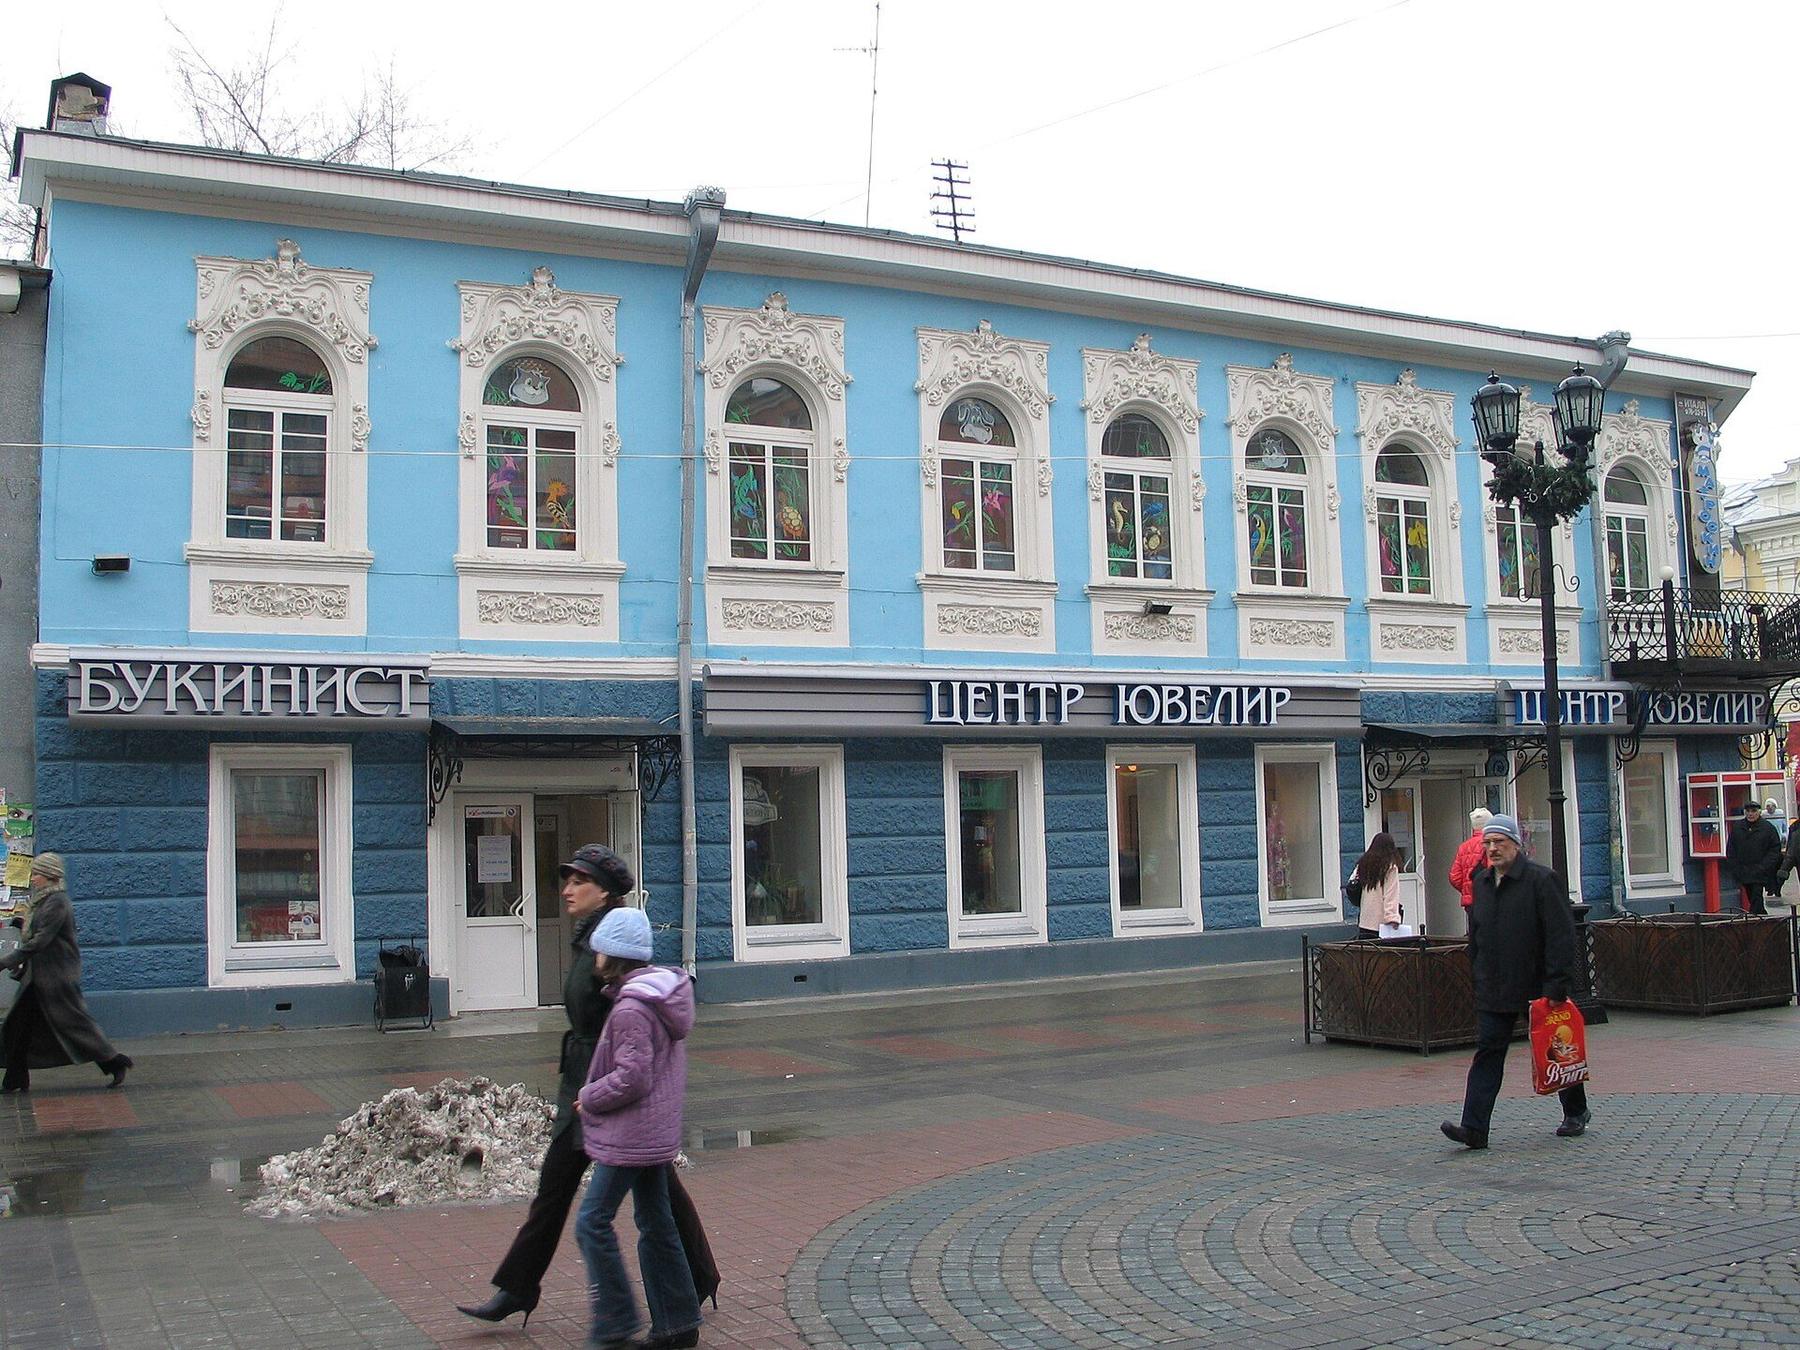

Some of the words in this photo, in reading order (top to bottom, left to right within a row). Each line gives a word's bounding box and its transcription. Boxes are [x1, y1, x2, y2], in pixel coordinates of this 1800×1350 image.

[78, 662, 425, 716] БУКИНИСТ
[928, 681, 1085, 725] ЦЕНТР
[1116, 684, 1292, 725] ЮВЕЛИР
[1519, 691, 1625, 726] ЦНТР
[1648, 692, 1765, 725] ЮВЕЛИР
